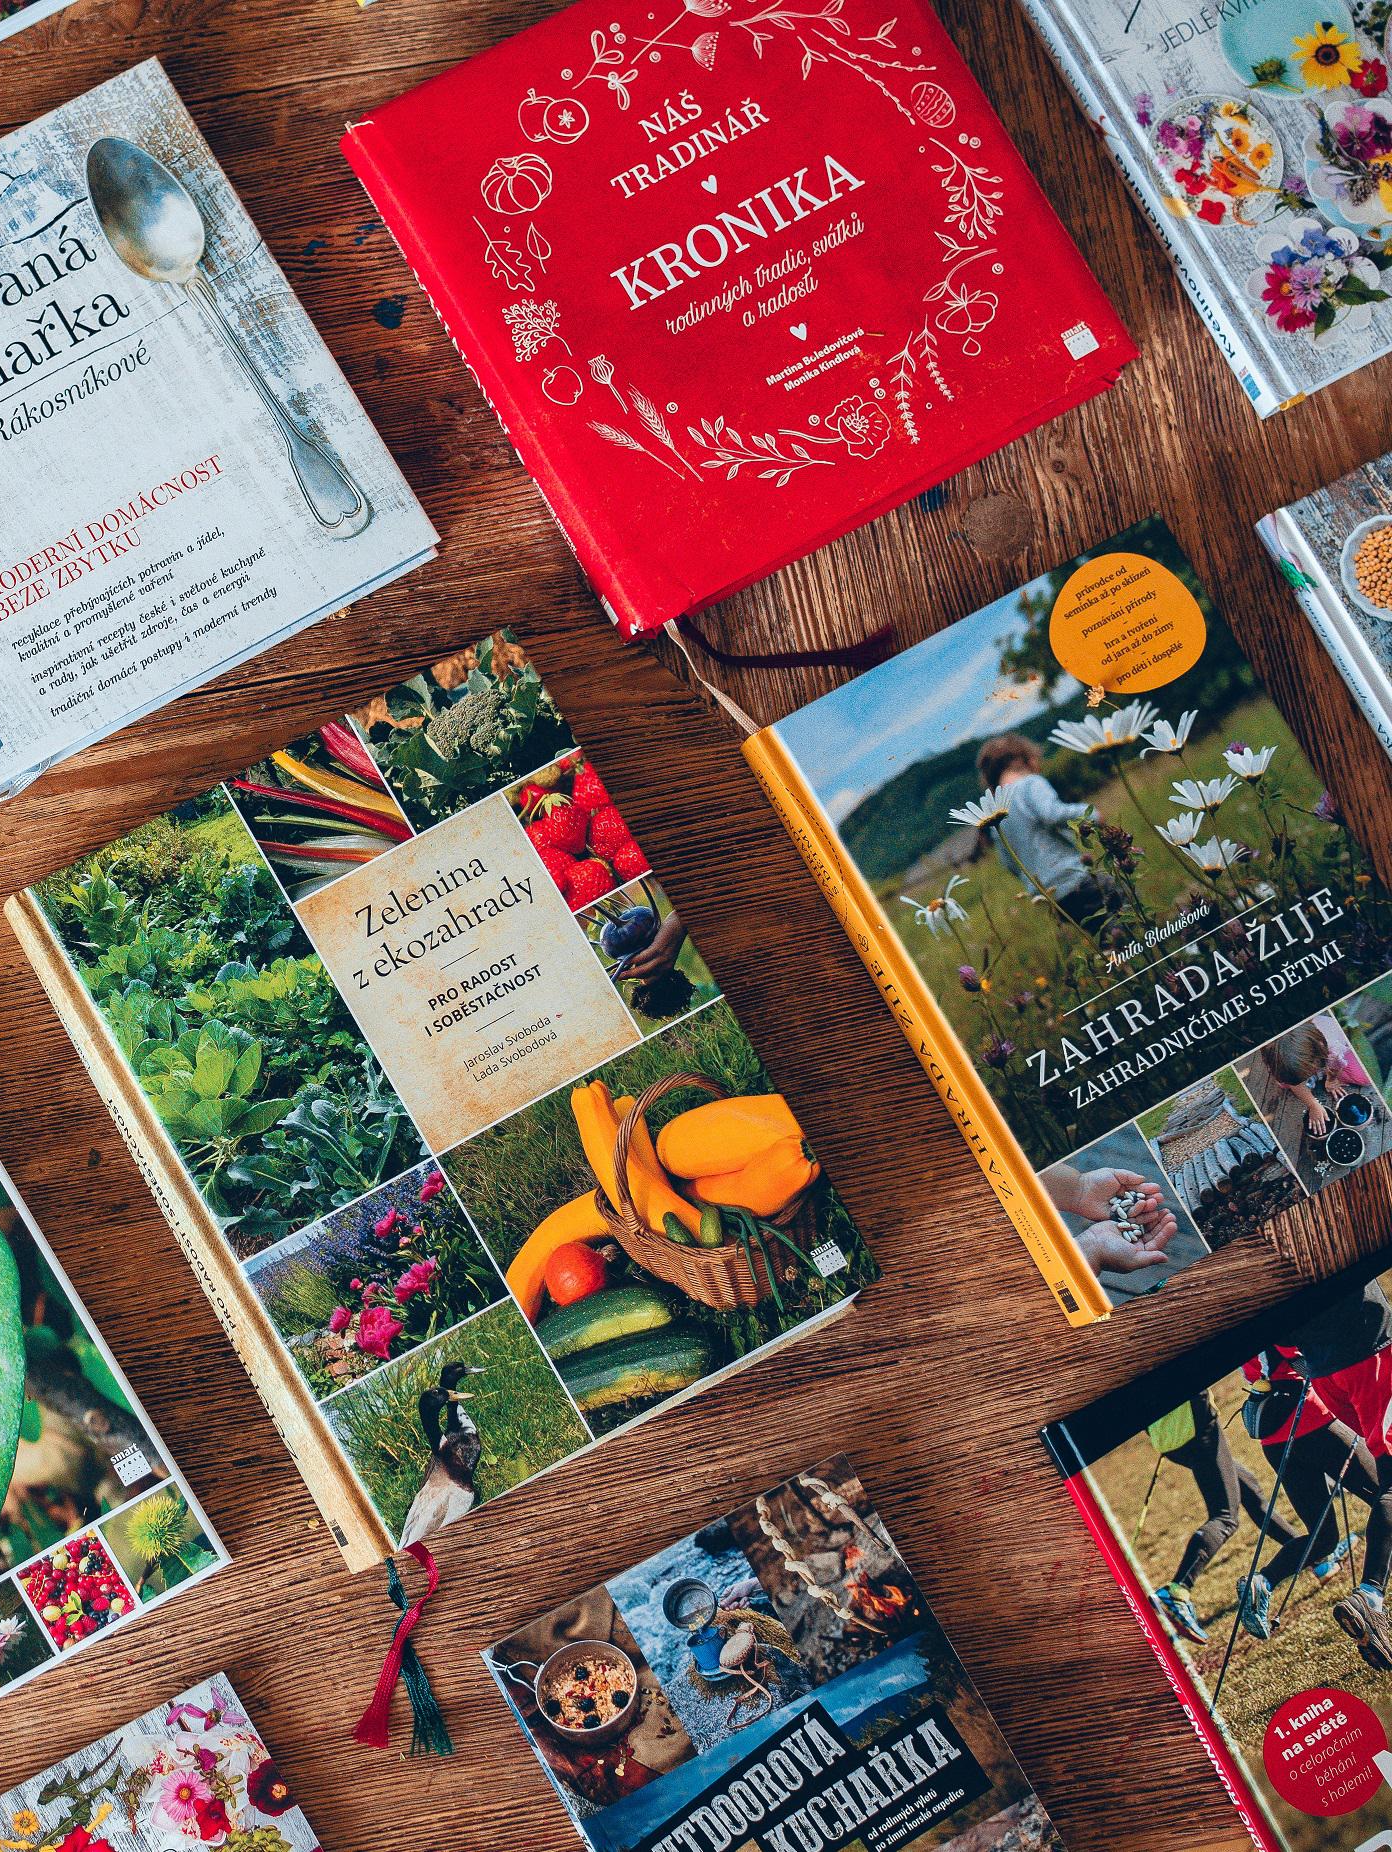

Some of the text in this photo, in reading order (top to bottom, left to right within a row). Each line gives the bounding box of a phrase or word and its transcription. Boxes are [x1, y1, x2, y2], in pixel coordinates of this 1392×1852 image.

[1159, 7, 1217, 53] JEDLÉ
[638, 89, 703, 143] NÁŠ
[610, 98, 770, 199] TRADINÁŘ
[610, 155, 866, 311] KRONIKA
[665, 211, 864, 334] rodinných tradic, svátků
[742, 266, 818, 327] a radostí
[765, 362, 803, 385] Martina
[783, 344, 861, 391] Monika Kindlová
[84, 454, 223, 543] DOMÁCNOST
[11, 526, 224, 649] recyklace přebývajících potravin a jídel,
[50, 526, 140, 588] ZBYTKU
[1075, 565, 1127, 601] průvodce od
[1081, 590, 1156, 638] poznávání přírody
[50, 685, 94, 717] tradiční
[97, 661, 137, 691] domácí
[139, 639, 182, 670] postupy
[192, 604, 239, 638] moderní
[241, 587, 276, 611] trendy
[354, 858, 488, 937] Zelenina
[352, 877, 533, 989] z ekozahrady
[1105, 900, 1211, 975] Anita Blahušová
[424, 963, 540, 1037] I SOBĚSTAČNOST
[427, 953, 517, 1010] PRO RADOST
[1025, 887, 1343, 1087] ZAHRADA ŽIJE
[463, 1017, 551, 1072] Jaroslav Svoboda
[1068, 939, 1345, 1108] ZAHRADNIČÍME S DĚTMI
[472, 1029, 557, 1082] Lada Svobodová
[870, 960, 1014, 1199] ZAHRADA ŽIJE
[109, 1442, 140, 1465] smart
[1273, 1698, 1333, 1739] 1. kniha
[1281, 1710, 1347, 1760] na světě
[1182, 1704, 1241, 1807] RUNNING
[1289, 1728, 1362, 1780] o celoročním
[1314, 1755, 1356, 1786] běhání
[763, 1718, 962, 1852] KUCHAŘKA
[867, 1788, 937, 1840] od rodinných výletů
[1321, 1765, 1371, 1807] s holemi!
